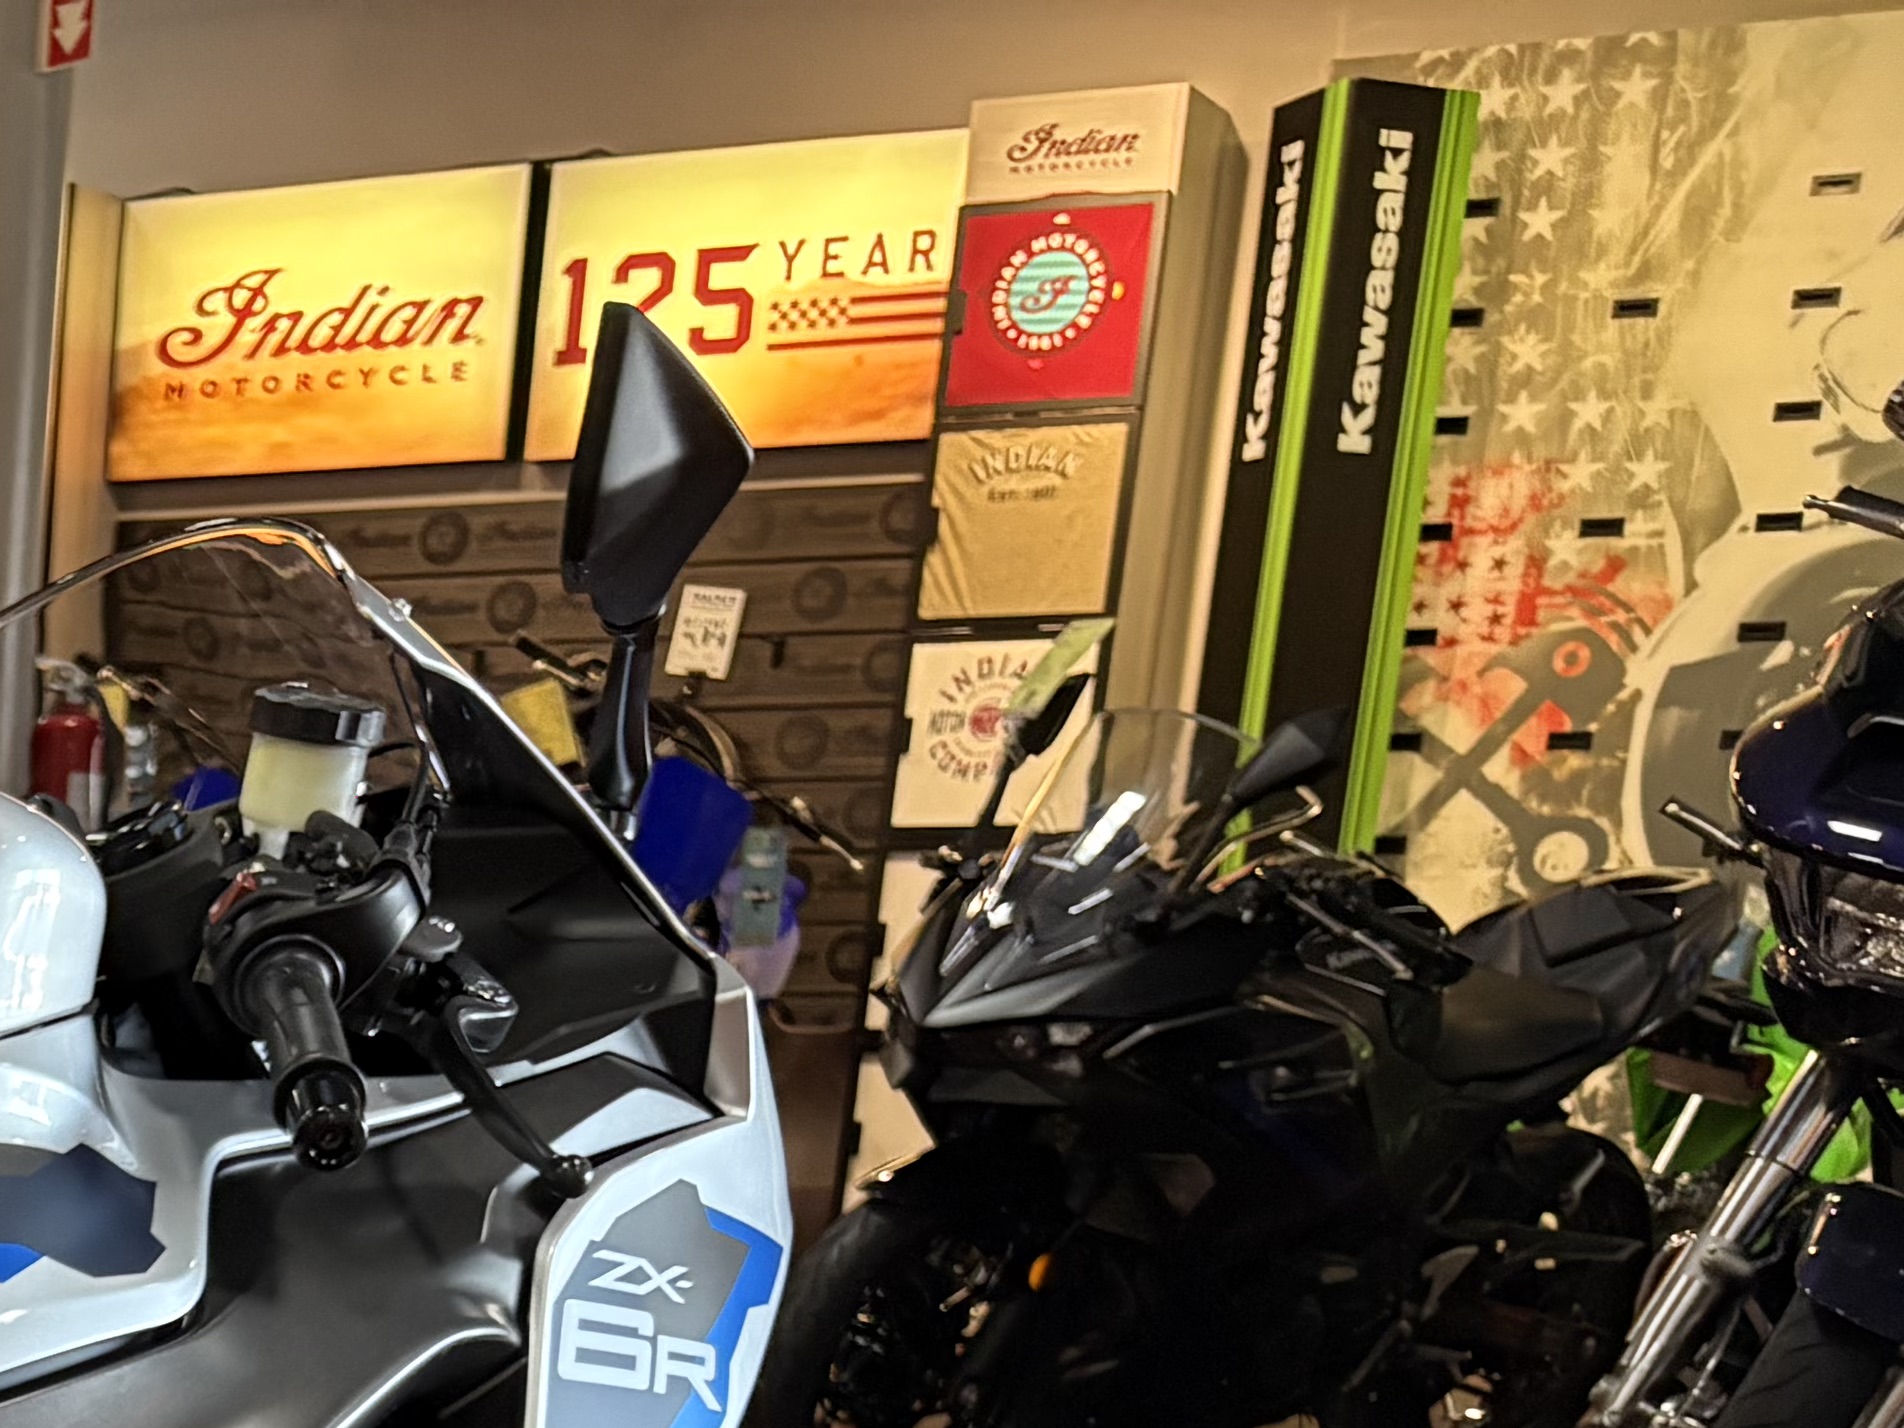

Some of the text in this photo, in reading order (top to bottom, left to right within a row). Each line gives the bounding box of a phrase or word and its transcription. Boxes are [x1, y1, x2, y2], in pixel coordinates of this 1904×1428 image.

[1006, 122, 1141, 163] Indian
[1008, 157, 1133, 174] MOTORCYCLE
[1242, 139, 1305, 462] Kawasaki
[1337, 128, 1413, 455] Kawasaki
[158, 267, 485, 369] Indian
[163, 361, 469, 401] MOTORCYCLE
[968, 443, 1084, 484] INDIAN
[939, 653, 1028, 703] INDIA
[557, 1299, 722, 1412] 6R
